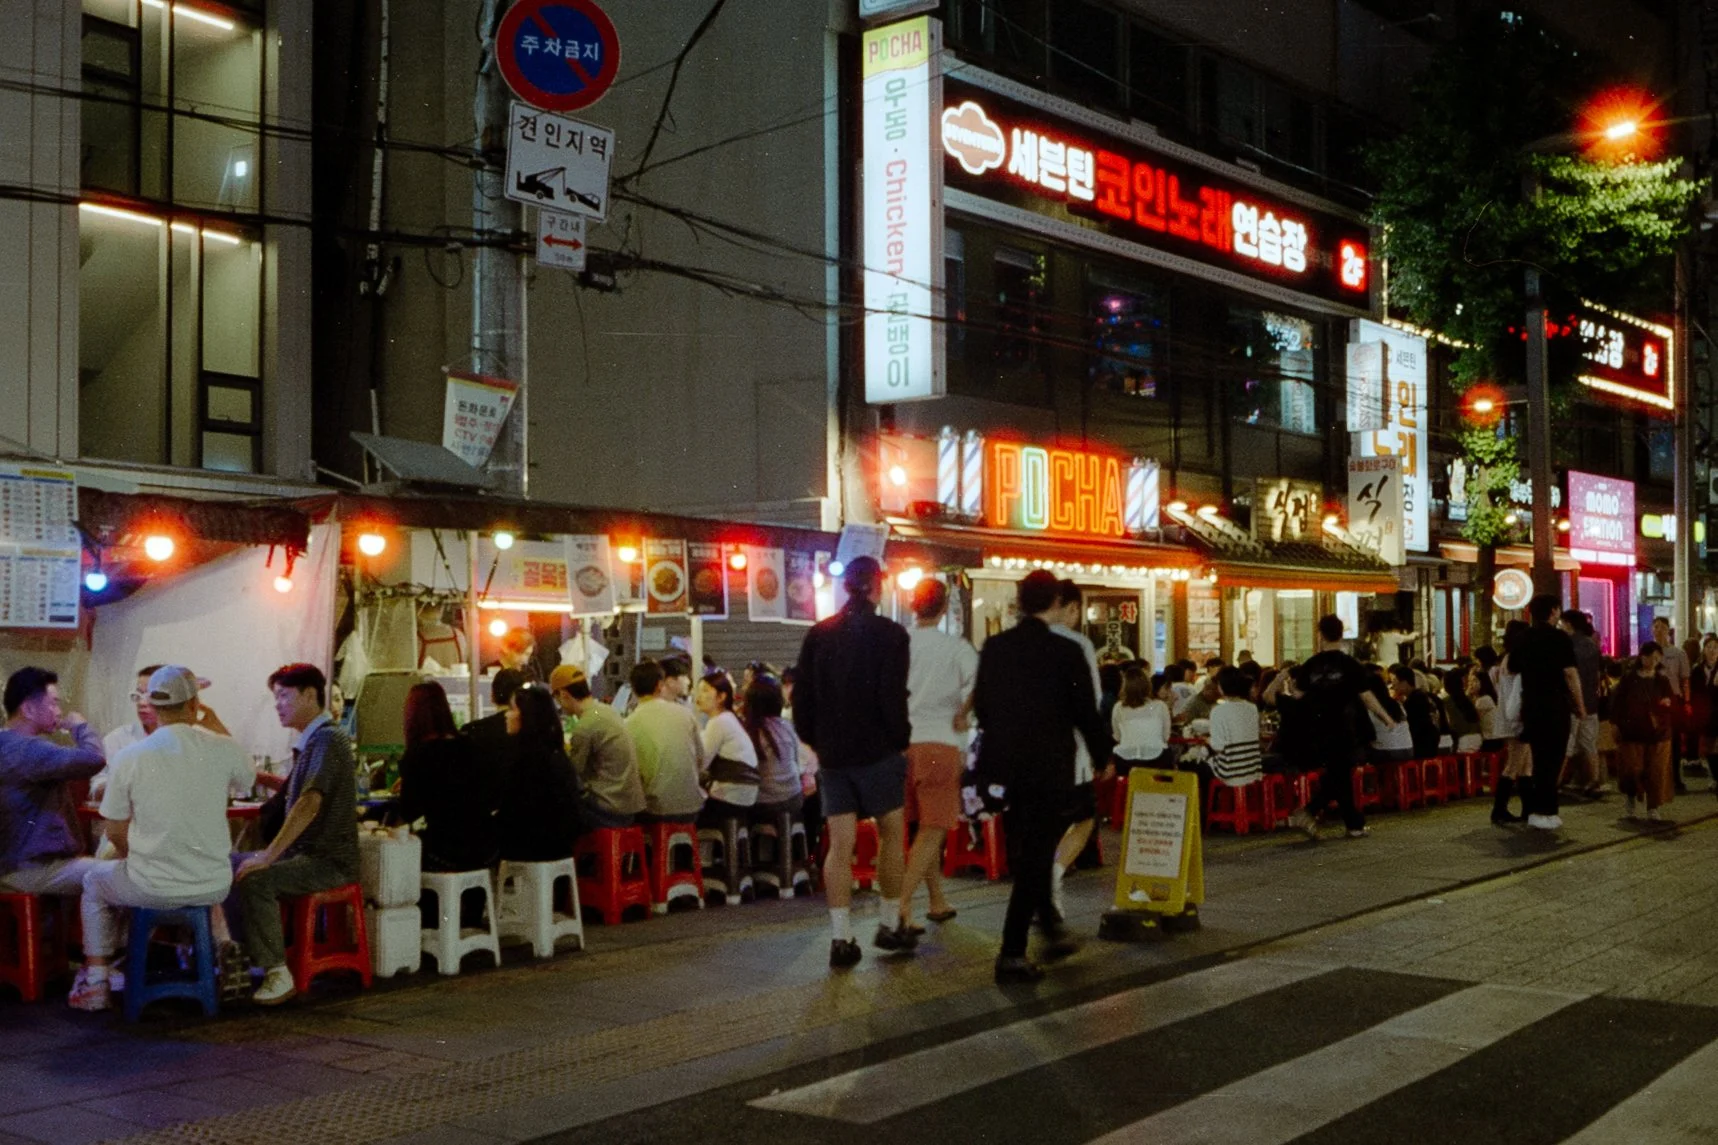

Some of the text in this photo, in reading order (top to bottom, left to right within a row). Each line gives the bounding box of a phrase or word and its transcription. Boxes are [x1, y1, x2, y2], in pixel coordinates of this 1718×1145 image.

[520, 35, 599, 61] 주차금지
[868, 30, 922, 63] POCHA
[518, 114, 607, 161] 견인지역
[886, 160, 908, 278] Chicken
[1232, 202, 1306, 272] 연습장
[994, 443, 1125, 536] POCHA
